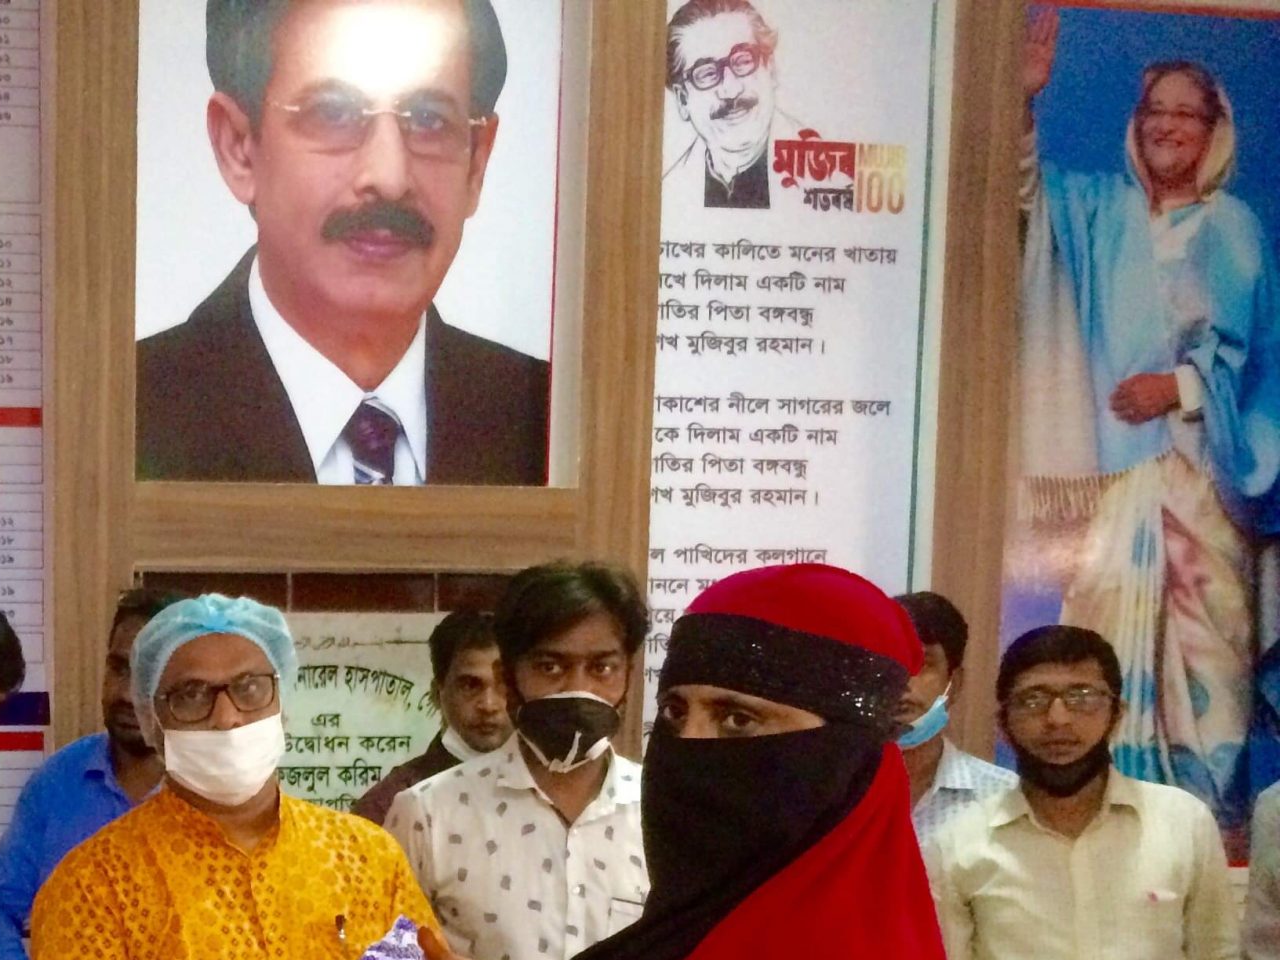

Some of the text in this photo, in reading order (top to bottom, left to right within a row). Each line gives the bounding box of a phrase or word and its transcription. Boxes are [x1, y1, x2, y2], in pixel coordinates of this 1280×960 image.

[772, 128, 857, 189] মুজিব
[714, 238, 782, 261] কালিতে
[788, 245, 837, 263] মনের
[843, 247, 899, 265] খাতায়
[695, 268, 749, 291] দিলাম
[756, 270, 807, 293] একটি
[814, 276, 846, 293] নাম
[708, 299, 751, 322] পিতা
[758, 305, 816, 328] বঙ্গবন্ধু
[686, 331, 748, 356] মুজিবুর
[726, 391, 770, 415] নীলে
[777, 396, 844, 416] সাগরের
[851, 399, 892, 417] জলে
[686, 422, 838, 446] দিলাম একটি নাম
[701, 453, 745, 475] পিতা
[752, 458, 809, 480] বঙ্গবন্ধু
[680, 482, 743, 508] মুজিবুর
[672, 543, 748, 565] পাখিদের
[310, 712, 342, 729] এর
[358, 735, 412, 754] করেন
[336, 757, 383, 788] করিম
